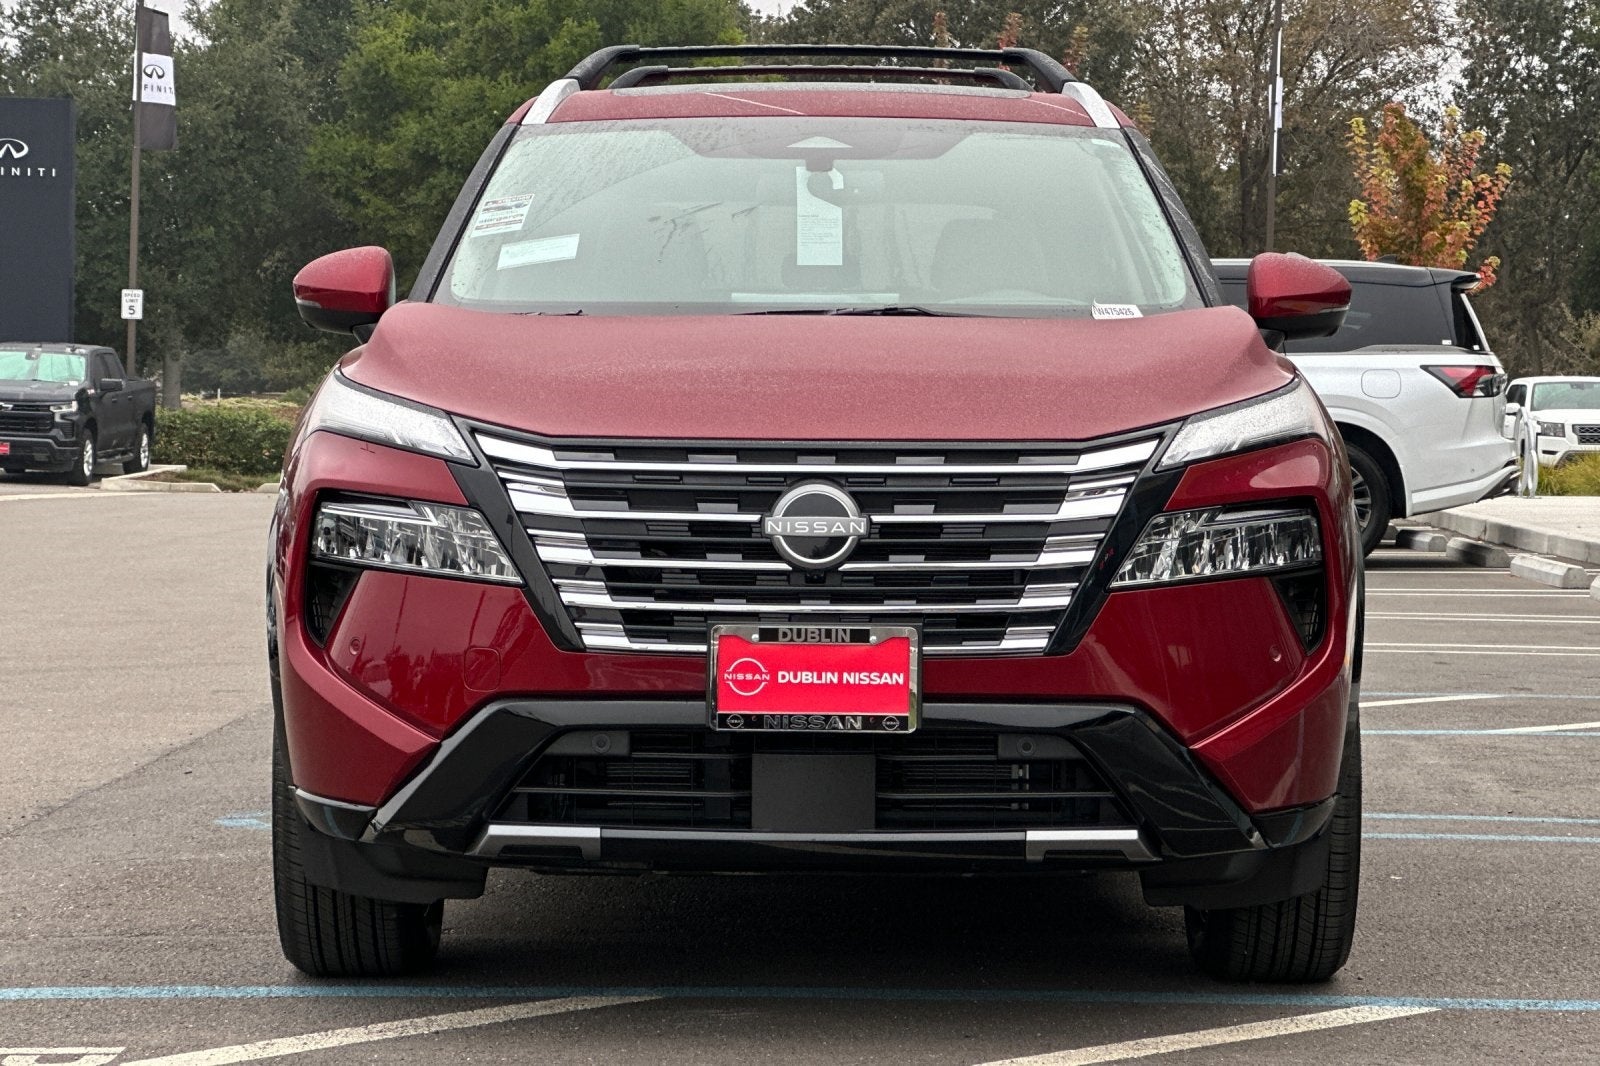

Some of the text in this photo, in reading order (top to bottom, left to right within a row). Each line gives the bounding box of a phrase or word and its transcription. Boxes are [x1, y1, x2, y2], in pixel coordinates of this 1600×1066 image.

[128, 305, 136, 315] 5
[767, 521, 864, 533] NISSAN
[778, 627, 850, 643] DUBLIN
[724, 673, 770, 681] NISSAN
[777, 671, 904, 685] DUBLIN NISSAN
[763, 714, 862, 730] NISSAN
